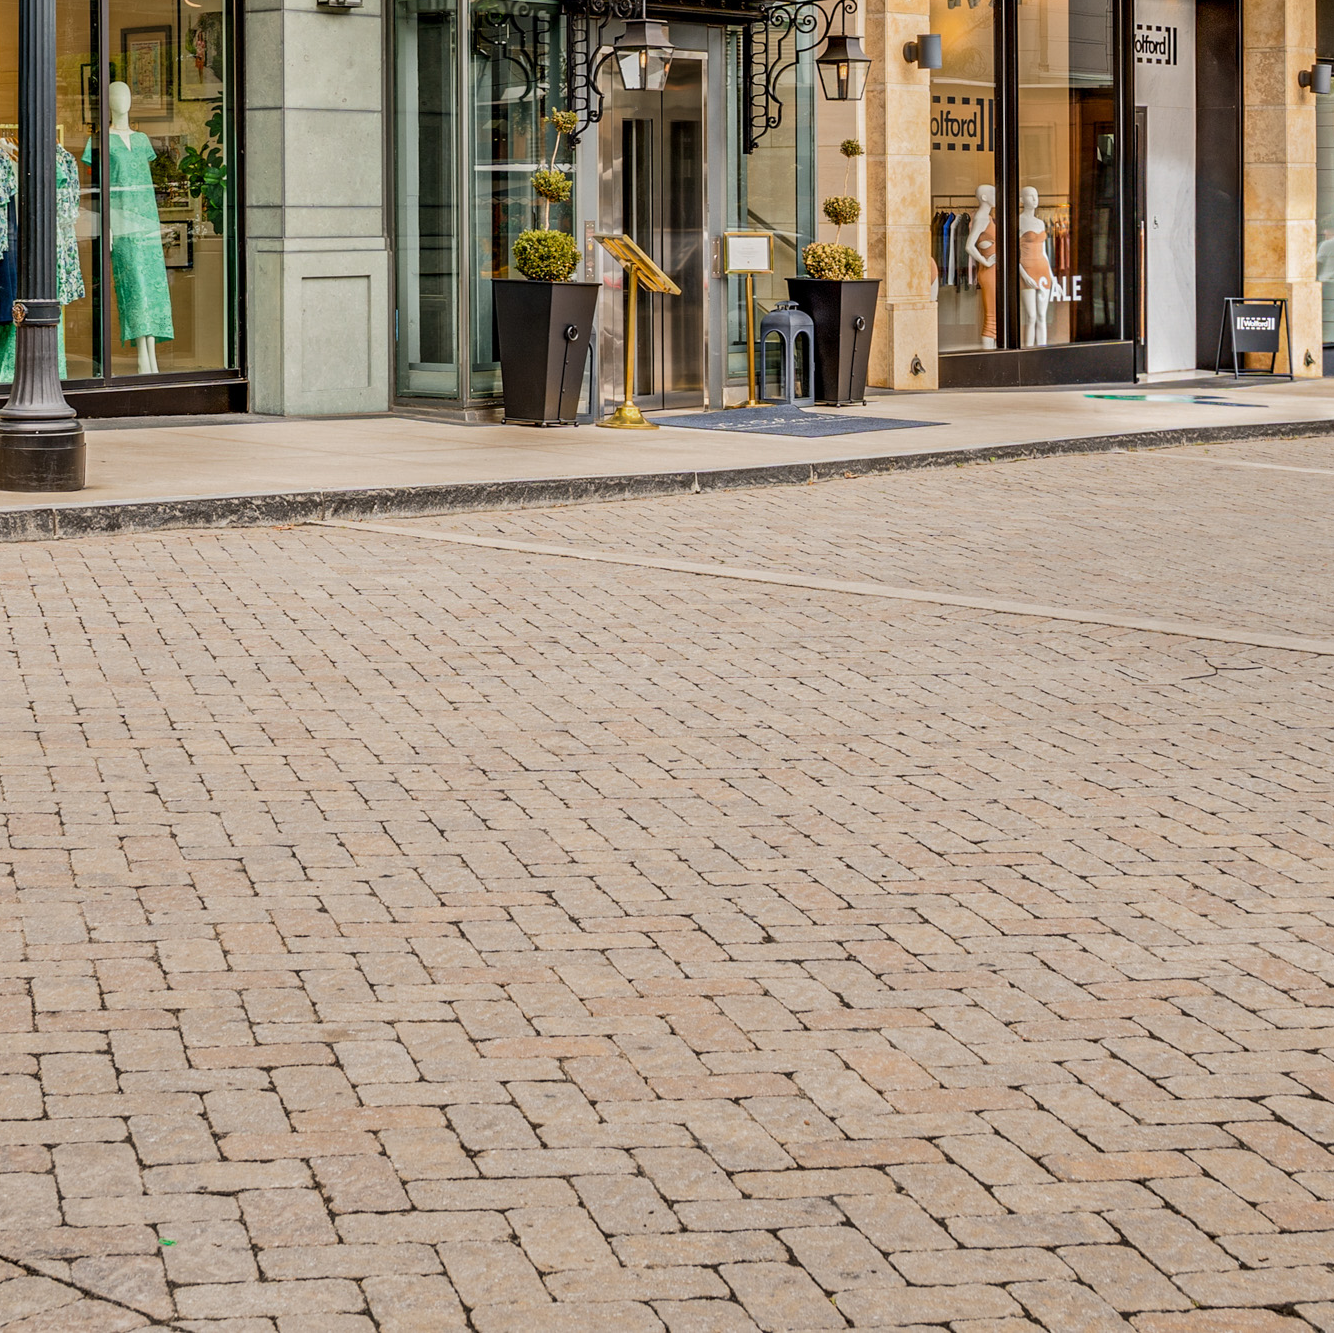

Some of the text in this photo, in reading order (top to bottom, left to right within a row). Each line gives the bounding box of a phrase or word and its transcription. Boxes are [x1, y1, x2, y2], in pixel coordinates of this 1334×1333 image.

[1134, 34, 1167, 56] olford
[930, 110, 977, 138] olford
[1038, 275, 1083, 302] SALE
